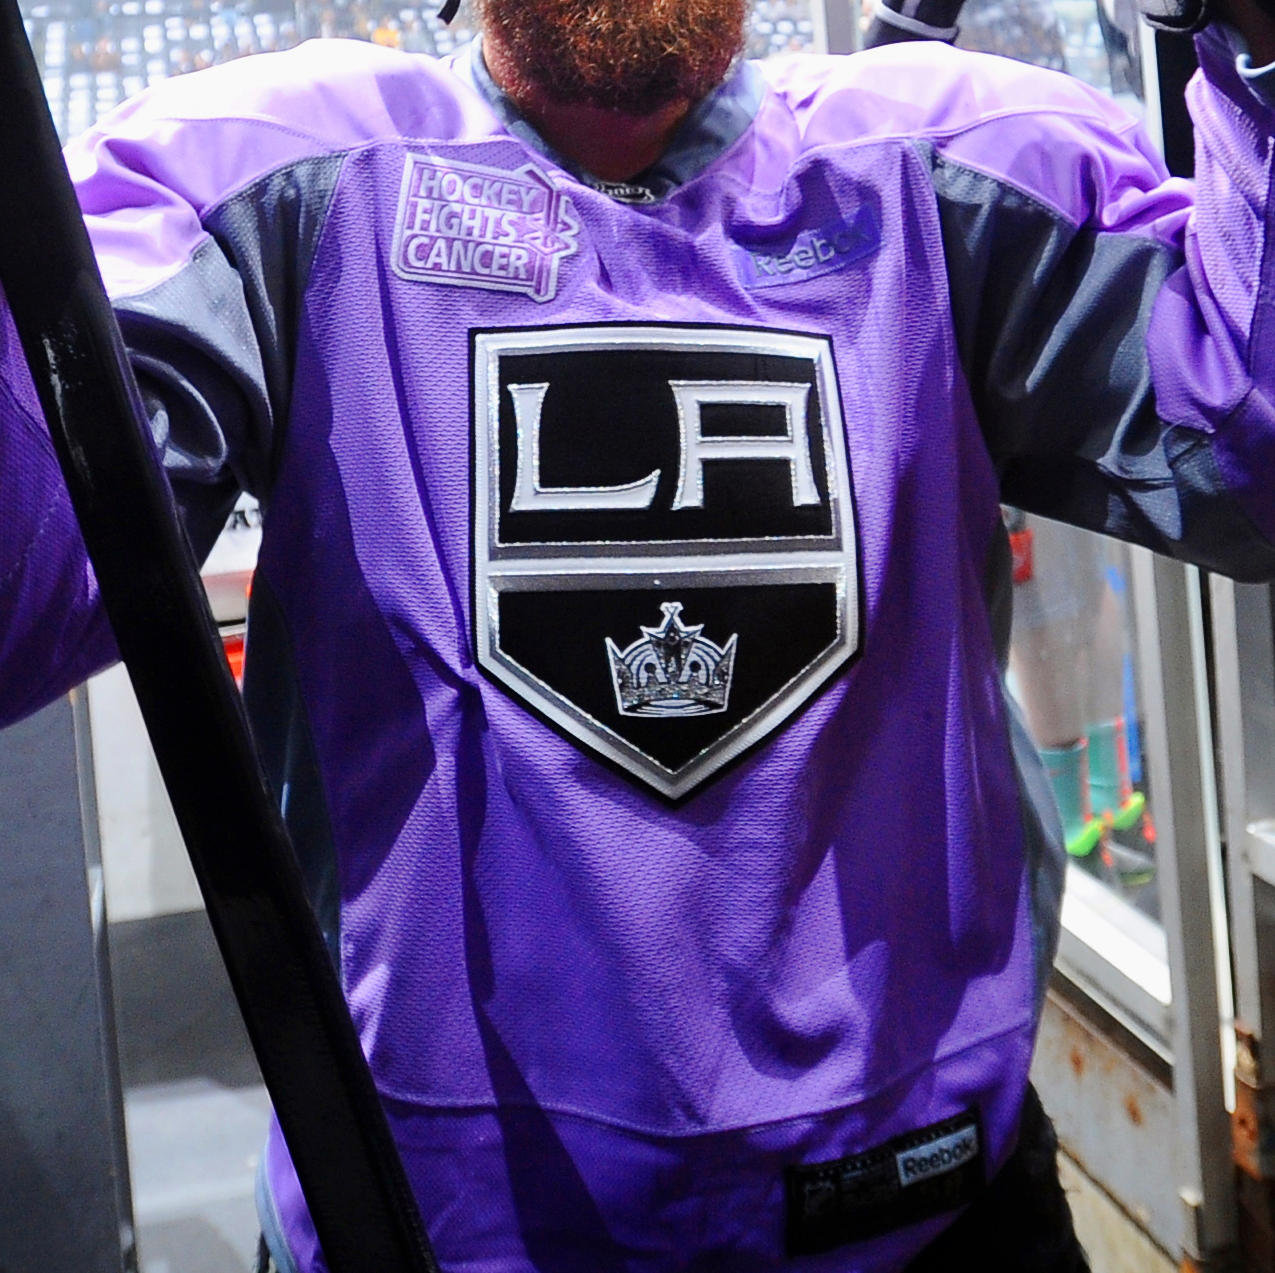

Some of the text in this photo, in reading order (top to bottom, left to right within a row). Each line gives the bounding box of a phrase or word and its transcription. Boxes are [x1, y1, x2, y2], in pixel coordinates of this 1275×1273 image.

[420, 168, 539, 213] HOCKEY
[413, 198, 518, 243] FIGHTS
[407, 233, 530, 278] CANCER
[750, 230, 859, 278] Reebo
[507, 379, 822, 514] LA
[902, 1136, 974, 1179] Reebok
